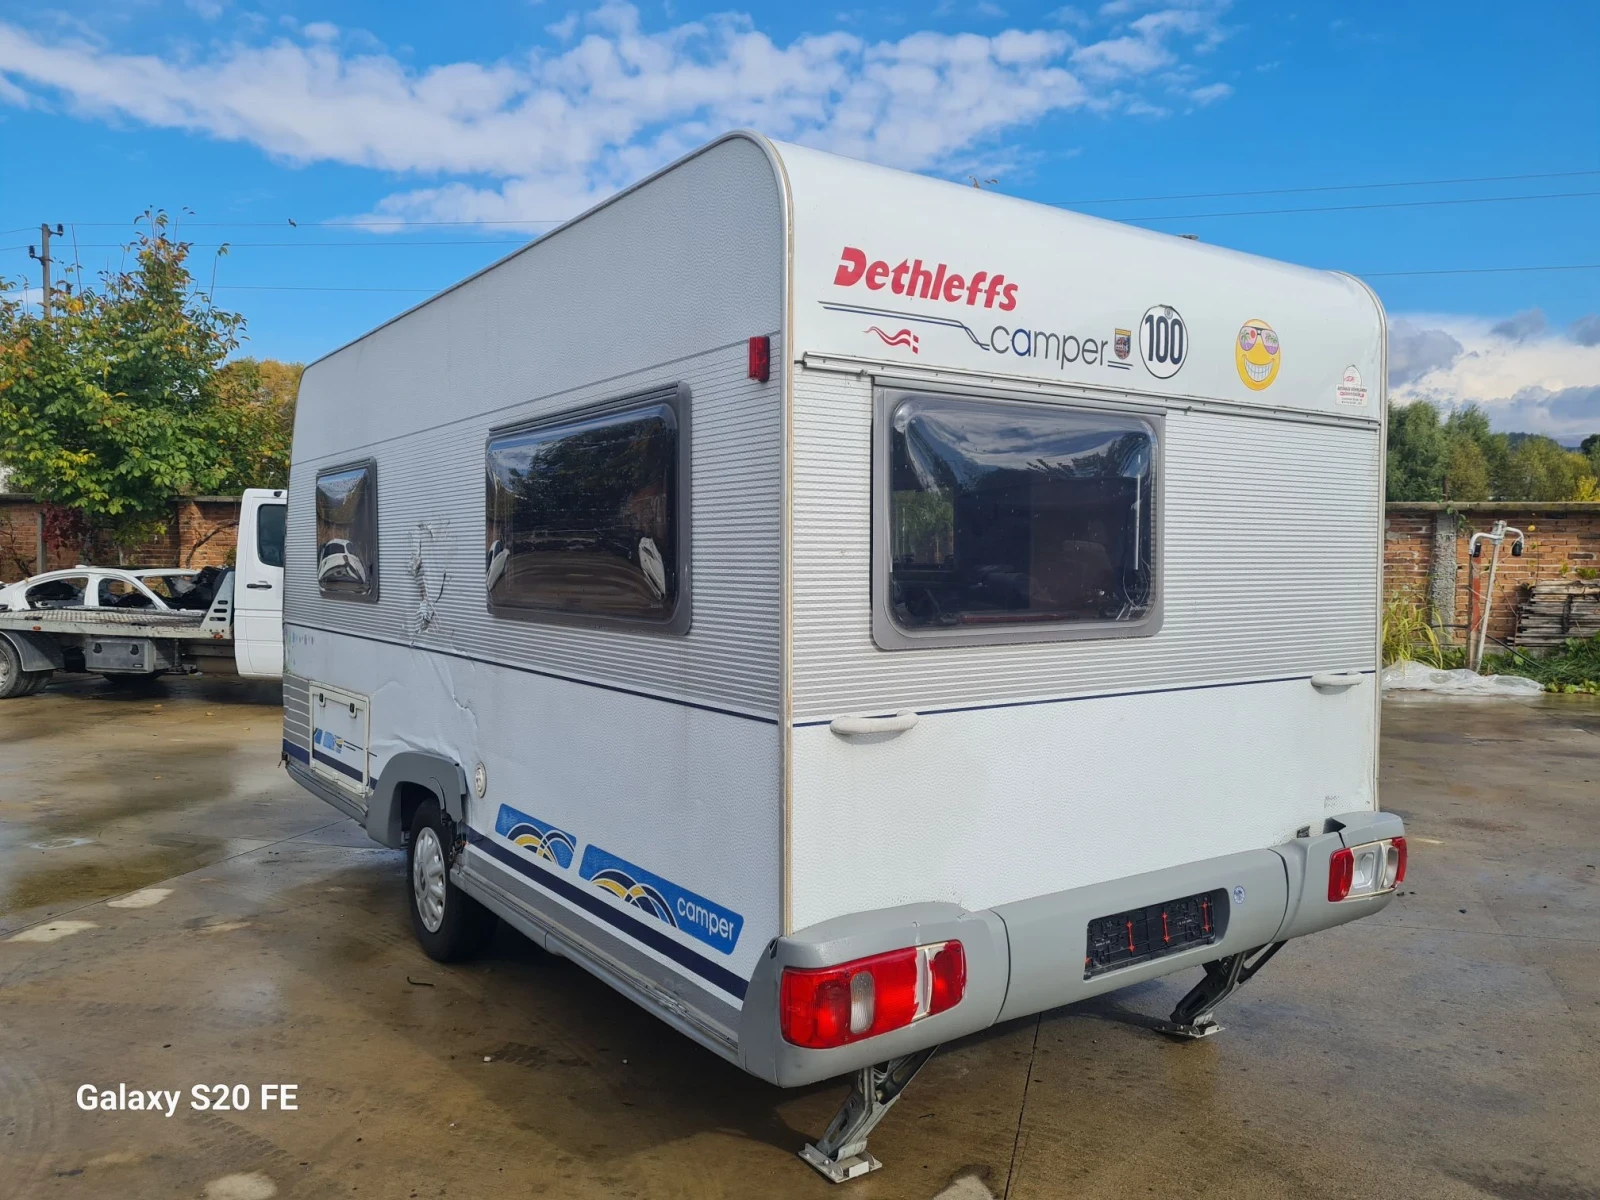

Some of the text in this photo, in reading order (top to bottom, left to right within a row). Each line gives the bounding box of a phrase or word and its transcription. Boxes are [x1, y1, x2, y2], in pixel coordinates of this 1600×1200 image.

[833, 246, 1018, 312] Dethleffs
[990, 325, 1108, 370] camper
[1144, 314, 1184, 365] 100
[677, 897, 734, 941] camper
